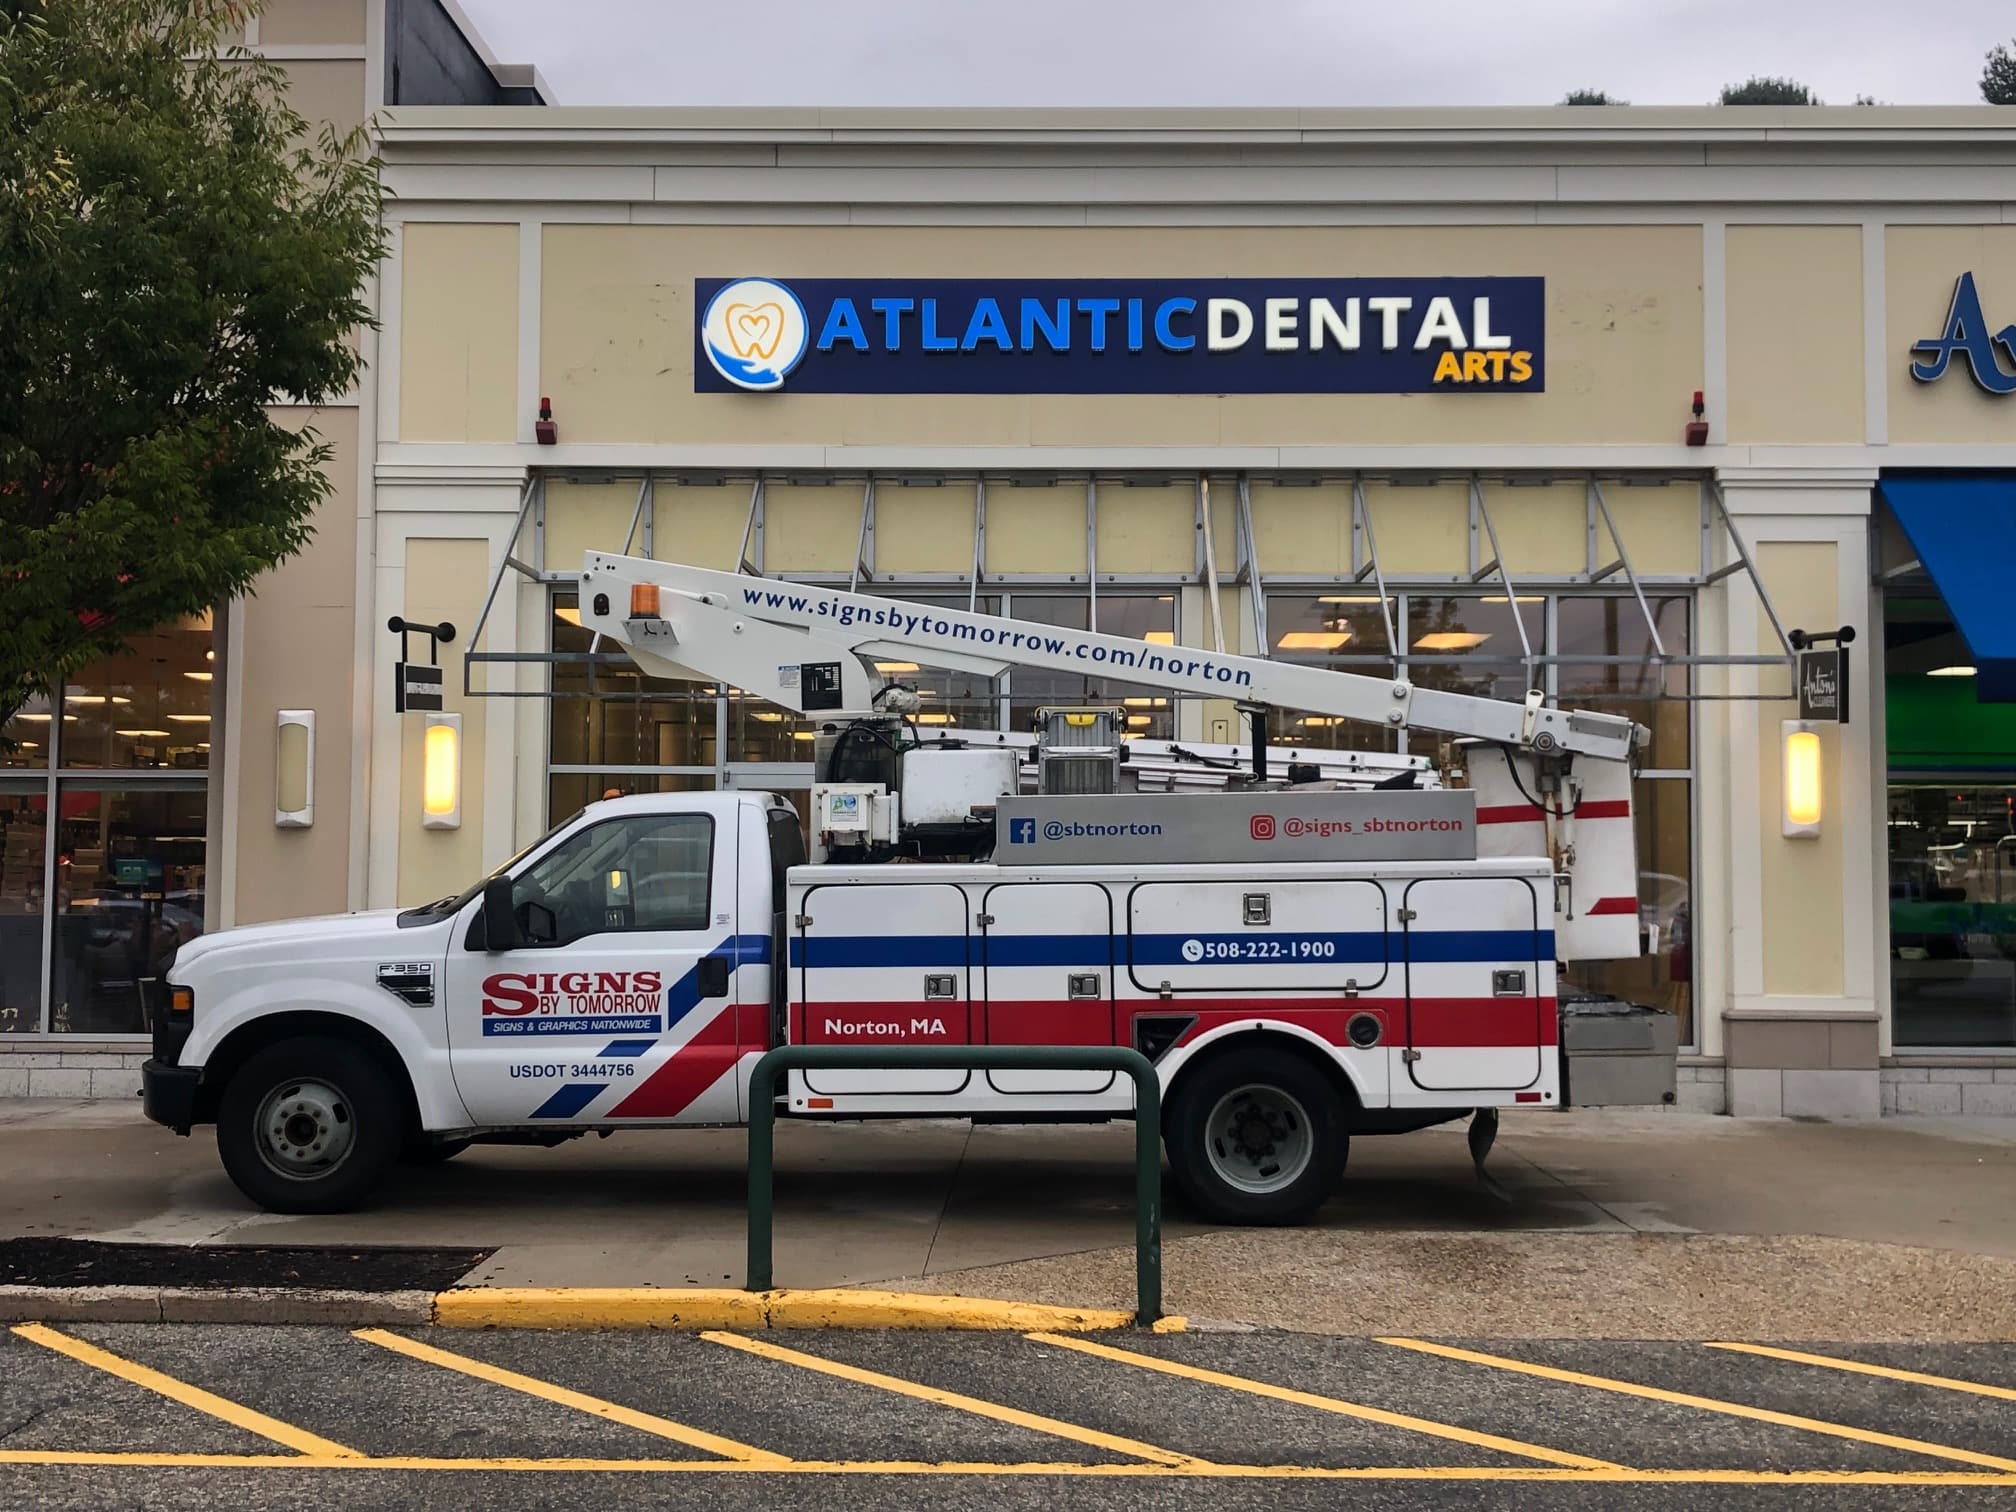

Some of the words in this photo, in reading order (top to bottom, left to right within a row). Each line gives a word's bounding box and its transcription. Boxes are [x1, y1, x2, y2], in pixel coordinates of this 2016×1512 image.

[1432, 350, 1534, 384] ARTS
[743, 585, 1252, 687] www.signsbytomorrow.com/norton
[1042, 820, 1163, 841] @sbtnorton
[1283, 817, 1463, 838] @signs_sbtnorton
[1205, 941, 1336, 959] 508-222-1900
[482, 971, 662, 1016] SIGNS
[540, 995, 560, 1015] BY
[568, 993, 661, 1015] TOMORROW
[493, 1022, 524, 1033] SIGNS
[527, 1021, 535, 1032] &
[538, 1020, 588, 1031] GRAPHICS
[591, 1018, 652, 1030] NATIONWIDE
[824, 1018, 906, 1038] Norton,
[910, 1018, 947, 1035] MA
[510, 1064, 567, 1078] USDOT
[571, 1063, 635, 1077] 3444756
